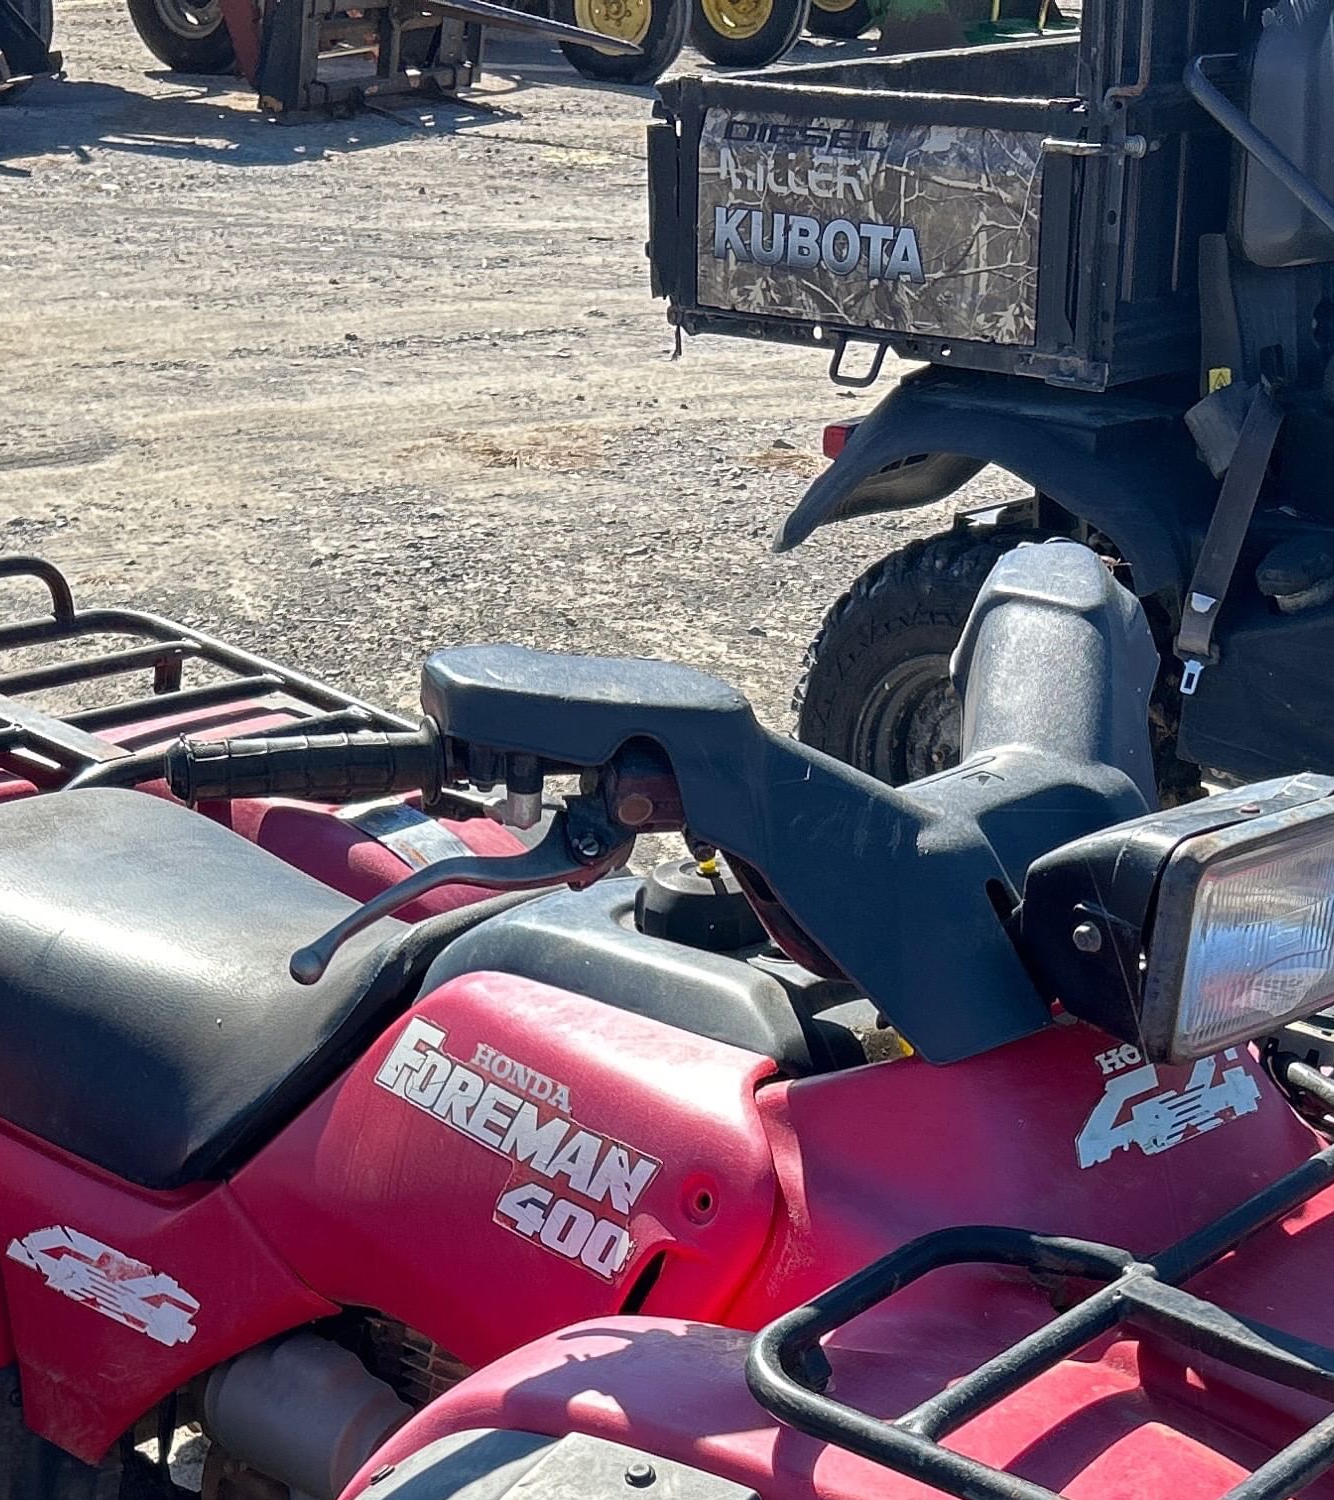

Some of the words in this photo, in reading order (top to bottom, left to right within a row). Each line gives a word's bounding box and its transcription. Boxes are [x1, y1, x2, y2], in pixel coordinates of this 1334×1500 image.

[722, 119, 888, 152] DIESEL
[713, 206, 925, 285] KUBOTA
[375, 1016, 661, 1216] FOREMAN
[470, 1042, 574, 1114] HONDA
[496, 1182, 633, 1281] 400
